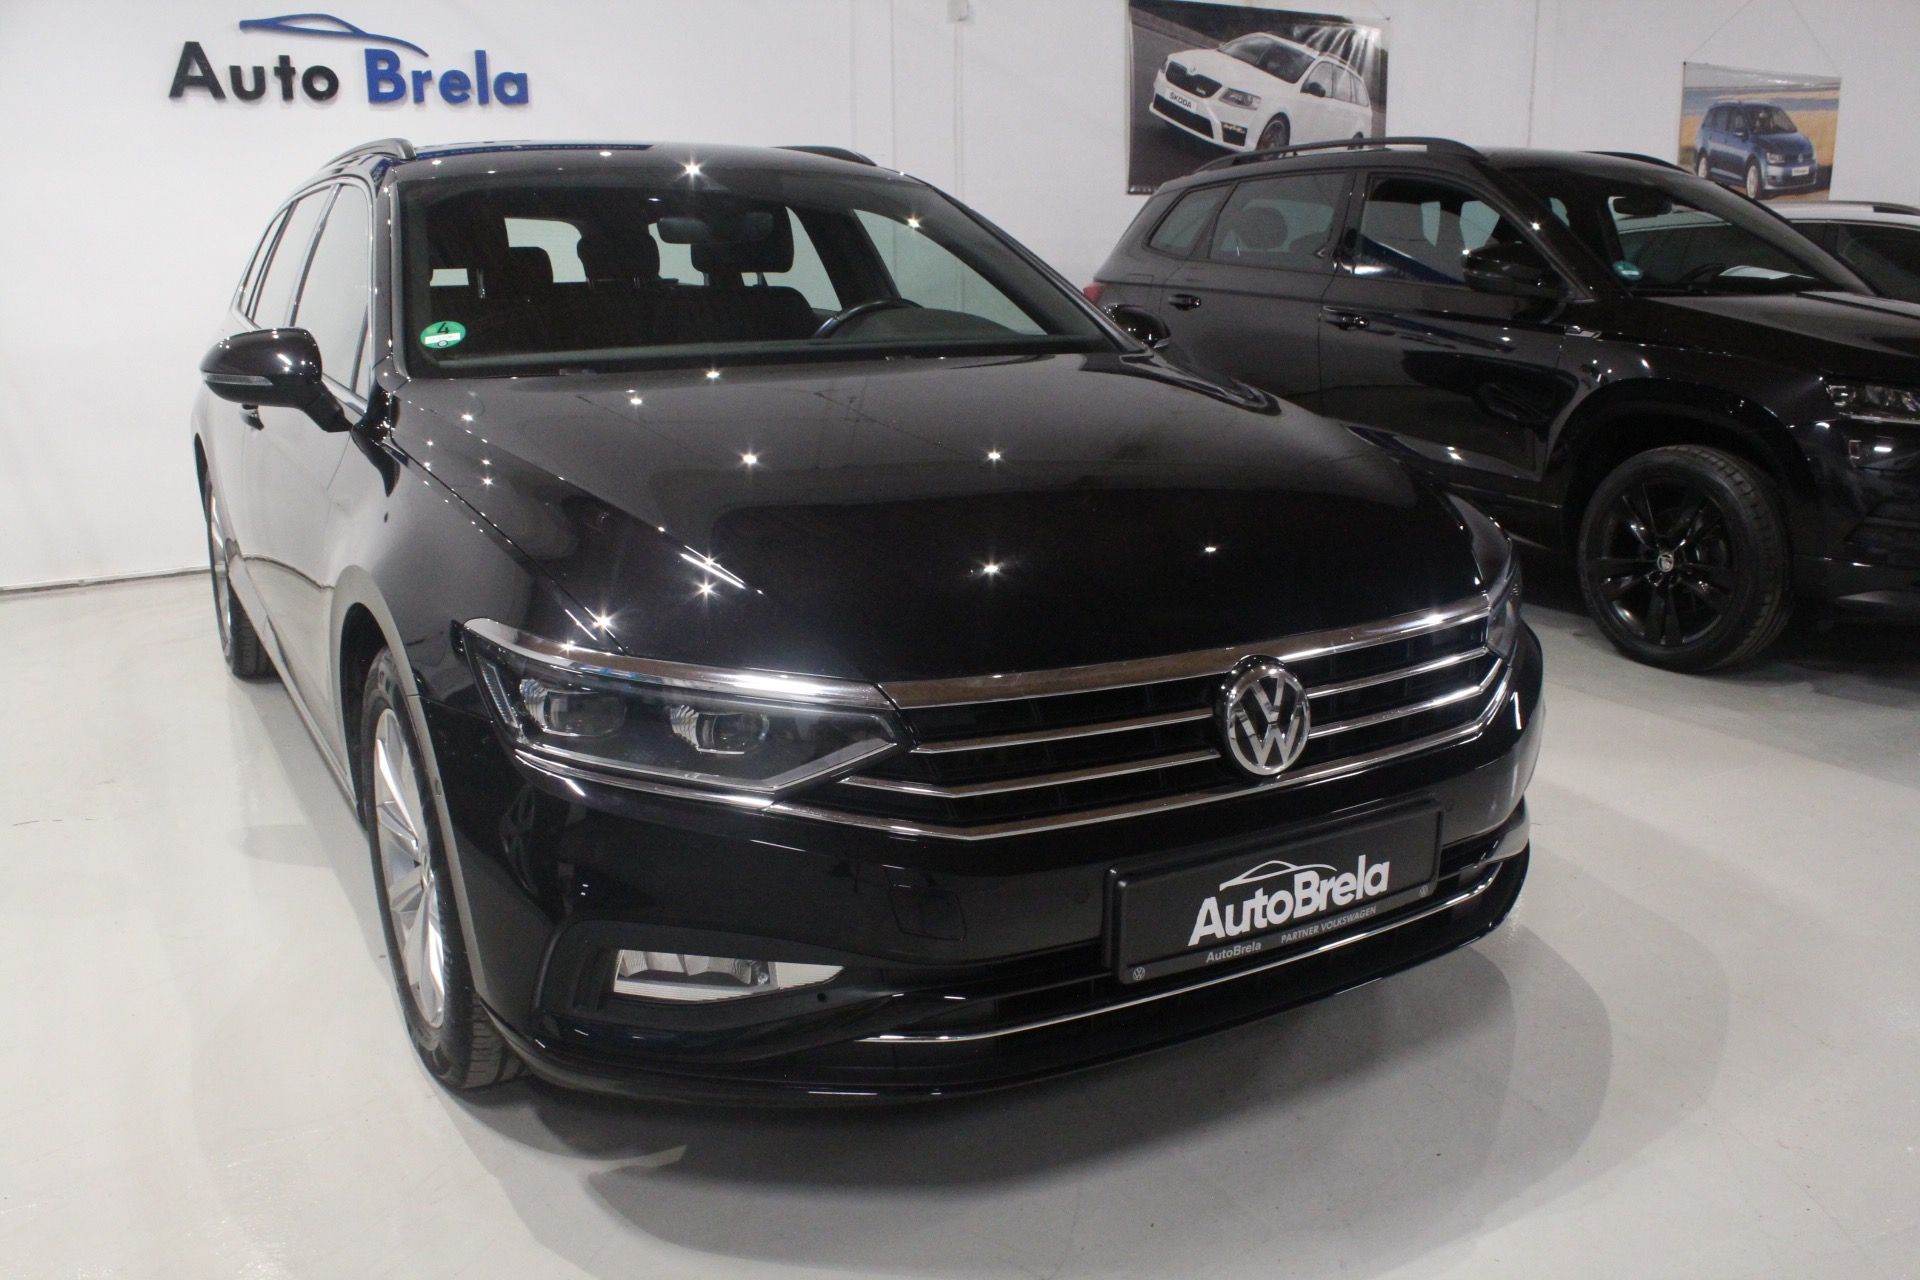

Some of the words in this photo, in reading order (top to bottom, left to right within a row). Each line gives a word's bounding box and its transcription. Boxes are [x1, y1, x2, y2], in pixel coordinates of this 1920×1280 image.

[169, 41, 339, 101] Auto
[365, 48, 529, 105] Brela
[437, 322, 449, 334] 4
[1187, 855, 1390, 946] AutoBrela
[1206, 941, 1261, 963] AutoBrela
[1281, 924, 1319, 944] PARTNER
[1321, 906, 1377, 932] VOLKSWAGEN
